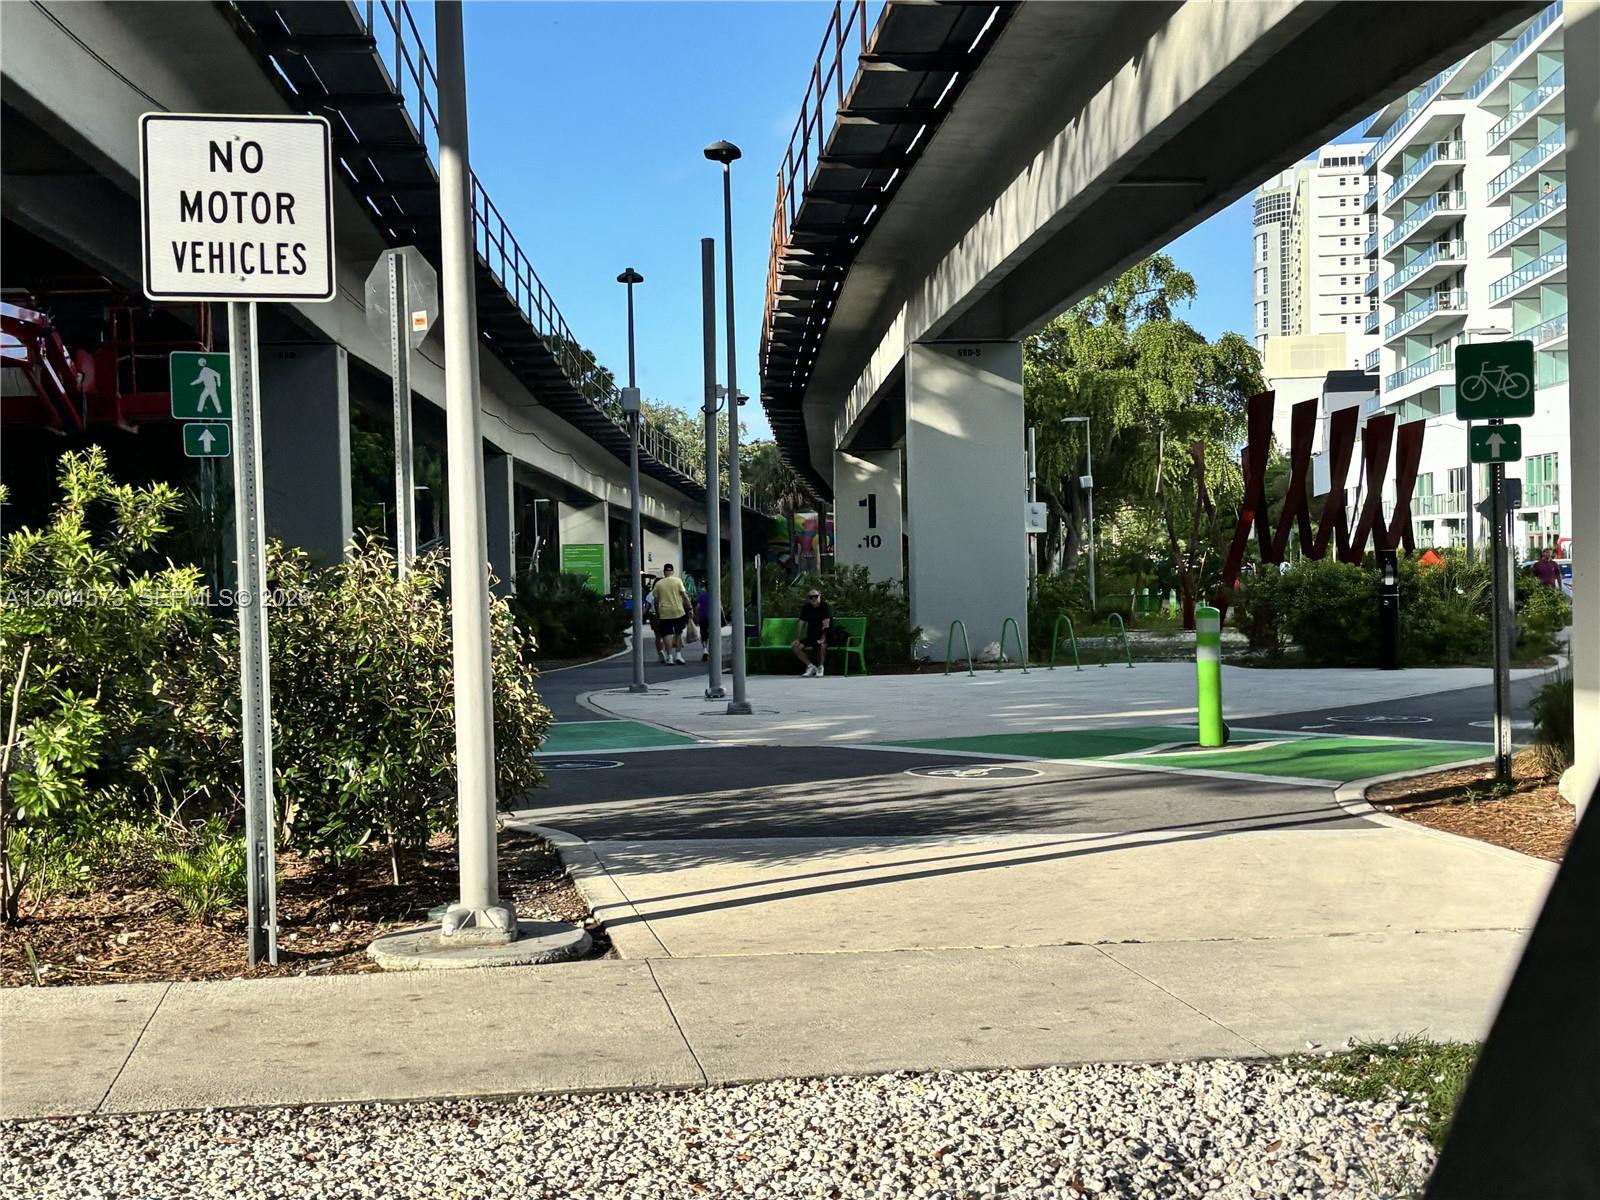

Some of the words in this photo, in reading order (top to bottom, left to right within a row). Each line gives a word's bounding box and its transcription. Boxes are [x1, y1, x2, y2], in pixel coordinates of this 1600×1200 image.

[209, 141, 264, 174] NO
[180, 190, 296, 225] MOTOR
[172, 241, 307, 275] VEHICLES
[858, 494, 877, 529] 1
